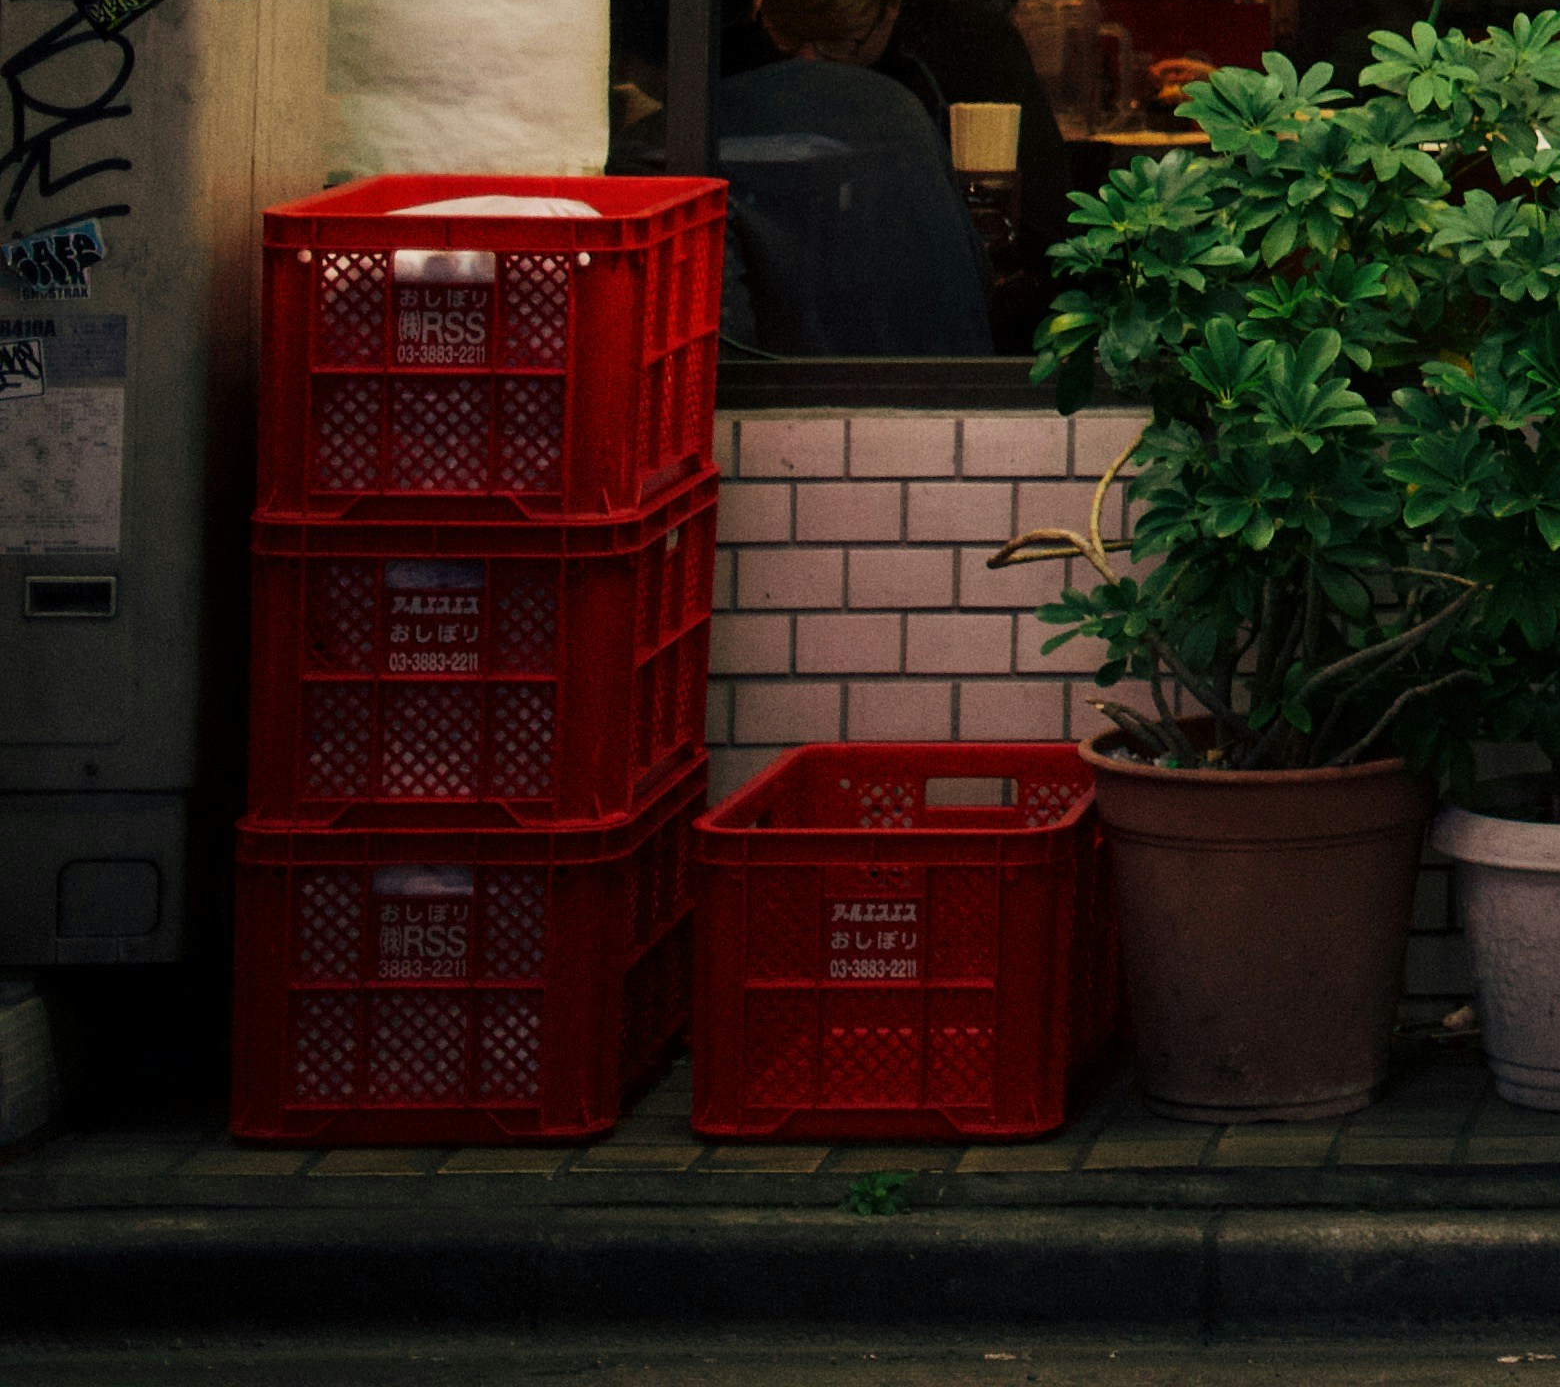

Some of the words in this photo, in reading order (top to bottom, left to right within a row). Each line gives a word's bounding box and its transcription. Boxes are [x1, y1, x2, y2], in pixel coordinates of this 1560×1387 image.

[399, 289, 488, 309] おしぼり
[396, 345, 486, 364] 03-3883-2211
[389, 623, 479, 644] おしぼり
[389, 652, 479, 672] 03-3883-2211
[380, 904, 469, 923] おしぼり
[830, 930, 917, 950] おしぼり
[378, 959, 466, 979] 3883-2211
[829, 958, 917, 979] 03-3883-2211
